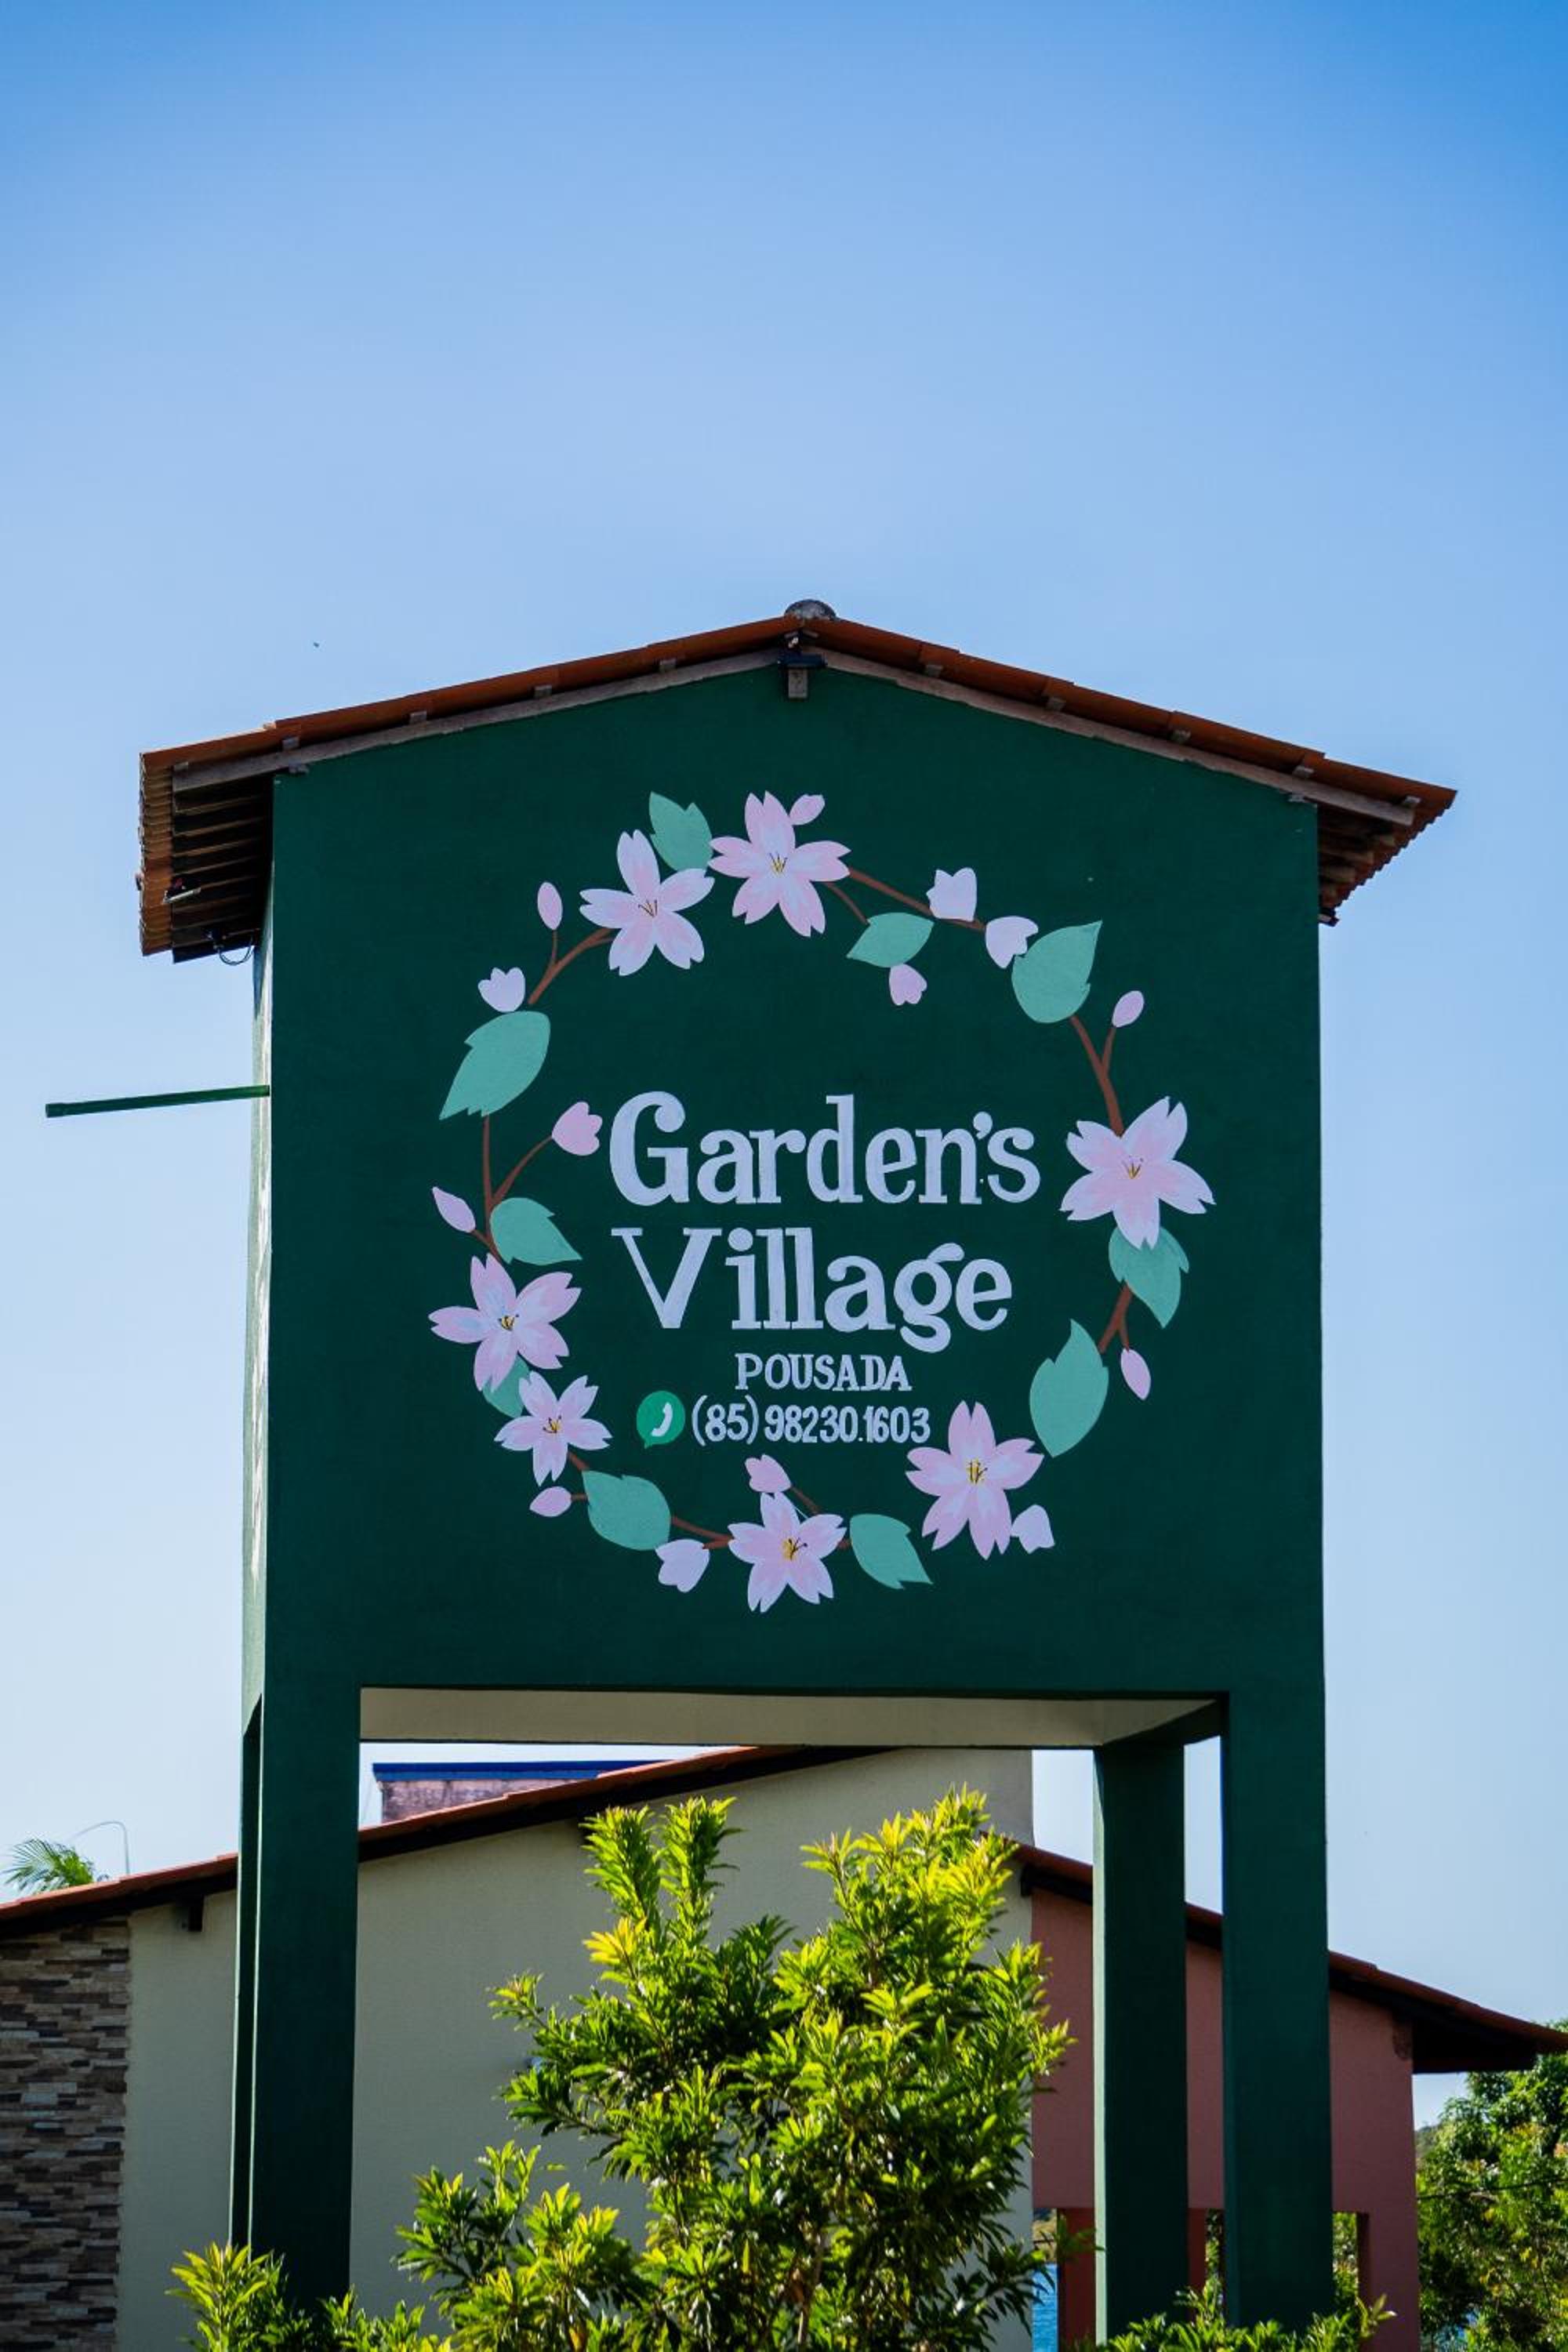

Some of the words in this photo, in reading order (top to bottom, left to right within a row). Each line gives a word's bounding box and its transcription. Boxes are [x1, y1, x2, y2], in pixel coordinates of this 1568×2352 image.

[609, 1091, 1041, 1207] Garden's
[611, 1226, 1013, 1352] Village
[735, 1353, 913, 1392] POUSADA
